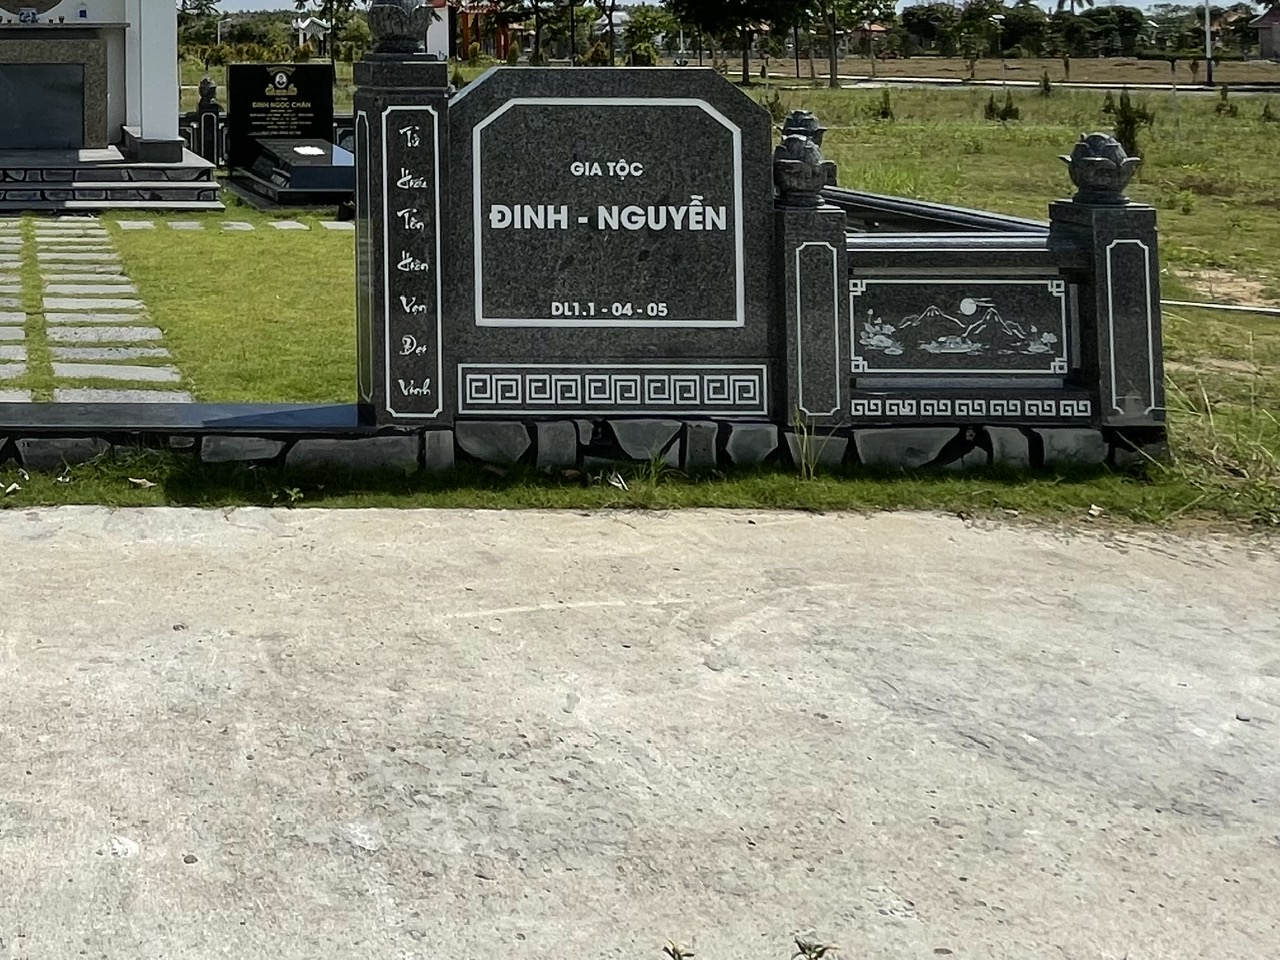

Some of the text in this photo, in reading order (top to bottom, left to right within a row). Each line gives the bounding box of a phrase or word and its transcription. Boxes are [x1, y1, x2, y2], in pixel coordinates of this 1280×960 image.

[570, 158, 644, 181] GIA TỘC
[489, 204, 568, 230] ĐINH
[597, 194, 727, 231] NGUYỄN
[551, 301, 596, 317] DL1.1
[611, 302, 633, 316] 04
[646, 302, 668, 316] 05
[397, 378, 431, 396] Vinh
